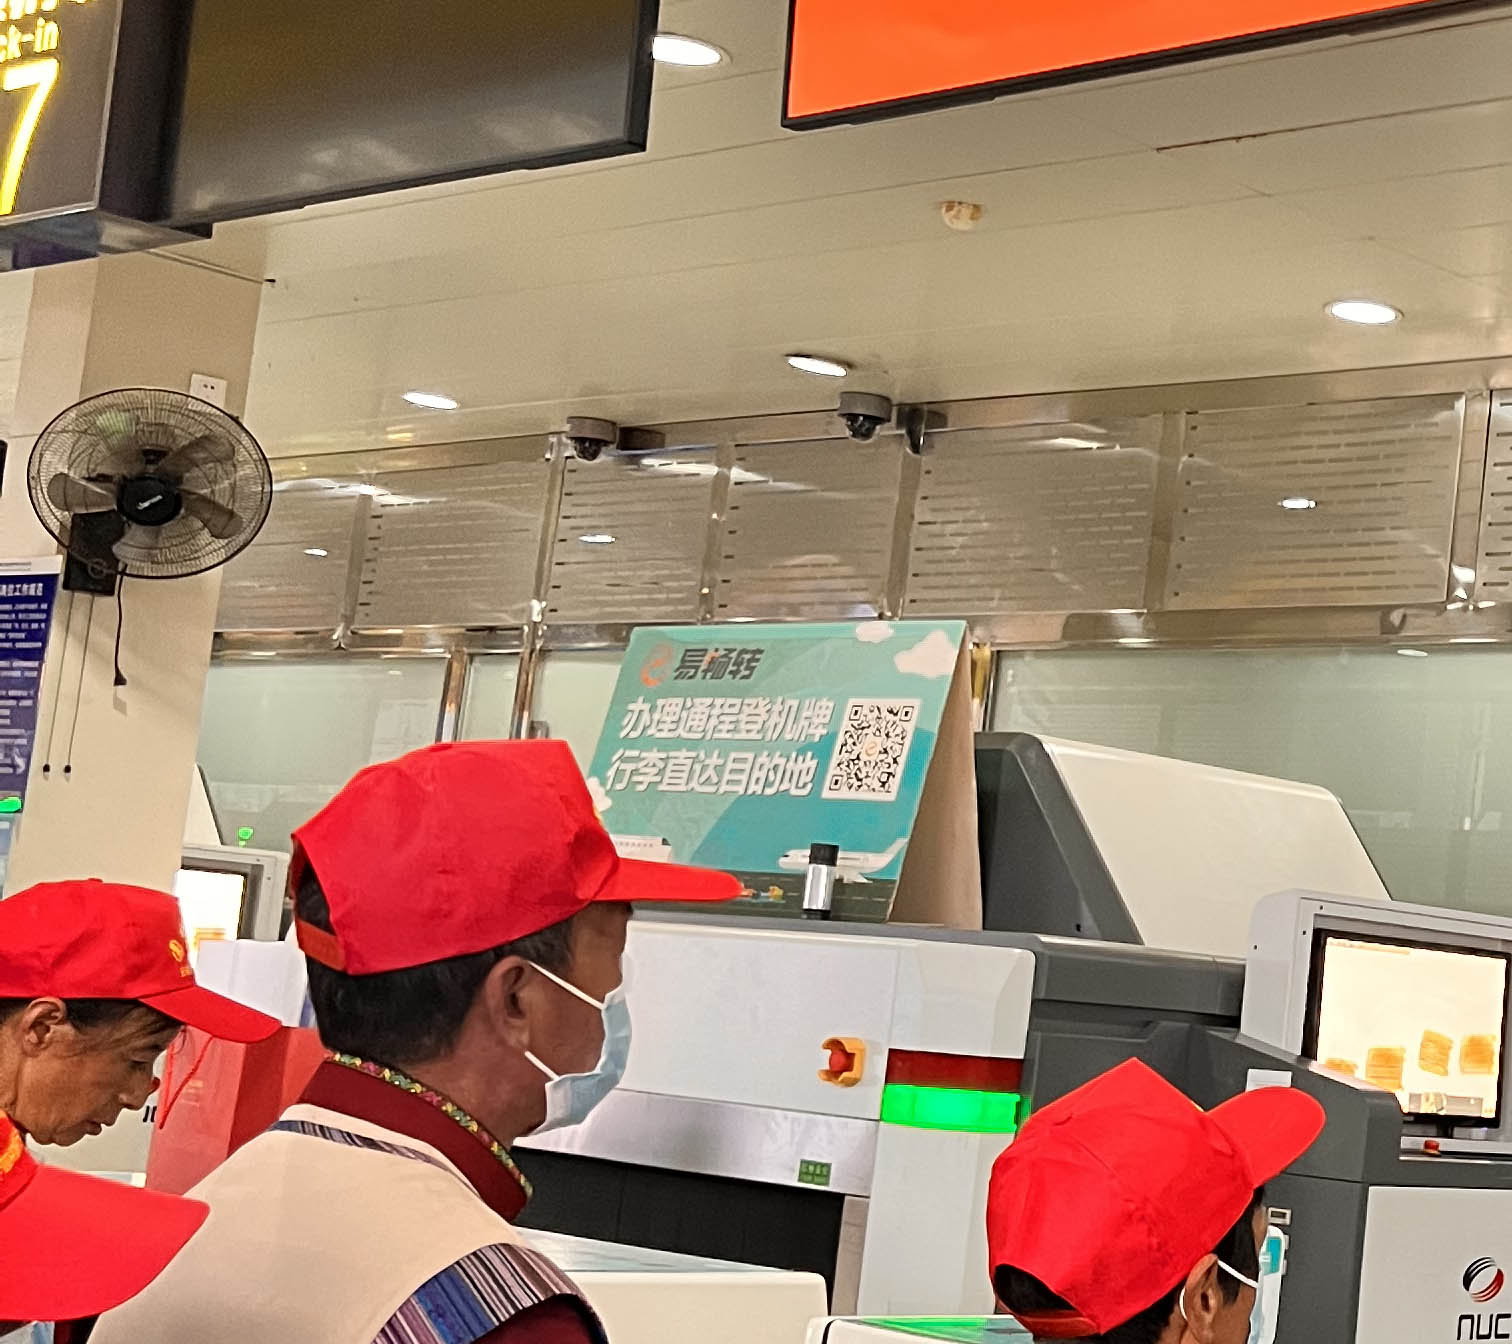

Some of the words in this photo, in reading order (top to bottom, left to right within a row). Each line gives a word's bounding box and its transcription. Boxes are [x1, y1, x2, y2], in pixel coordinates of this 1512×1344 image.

[673, 648, 765, 682] 易畅转
[618, 697, 837, 743] 办理通程登机牌
[605, 749, 820, 797] 行李直达目的地
